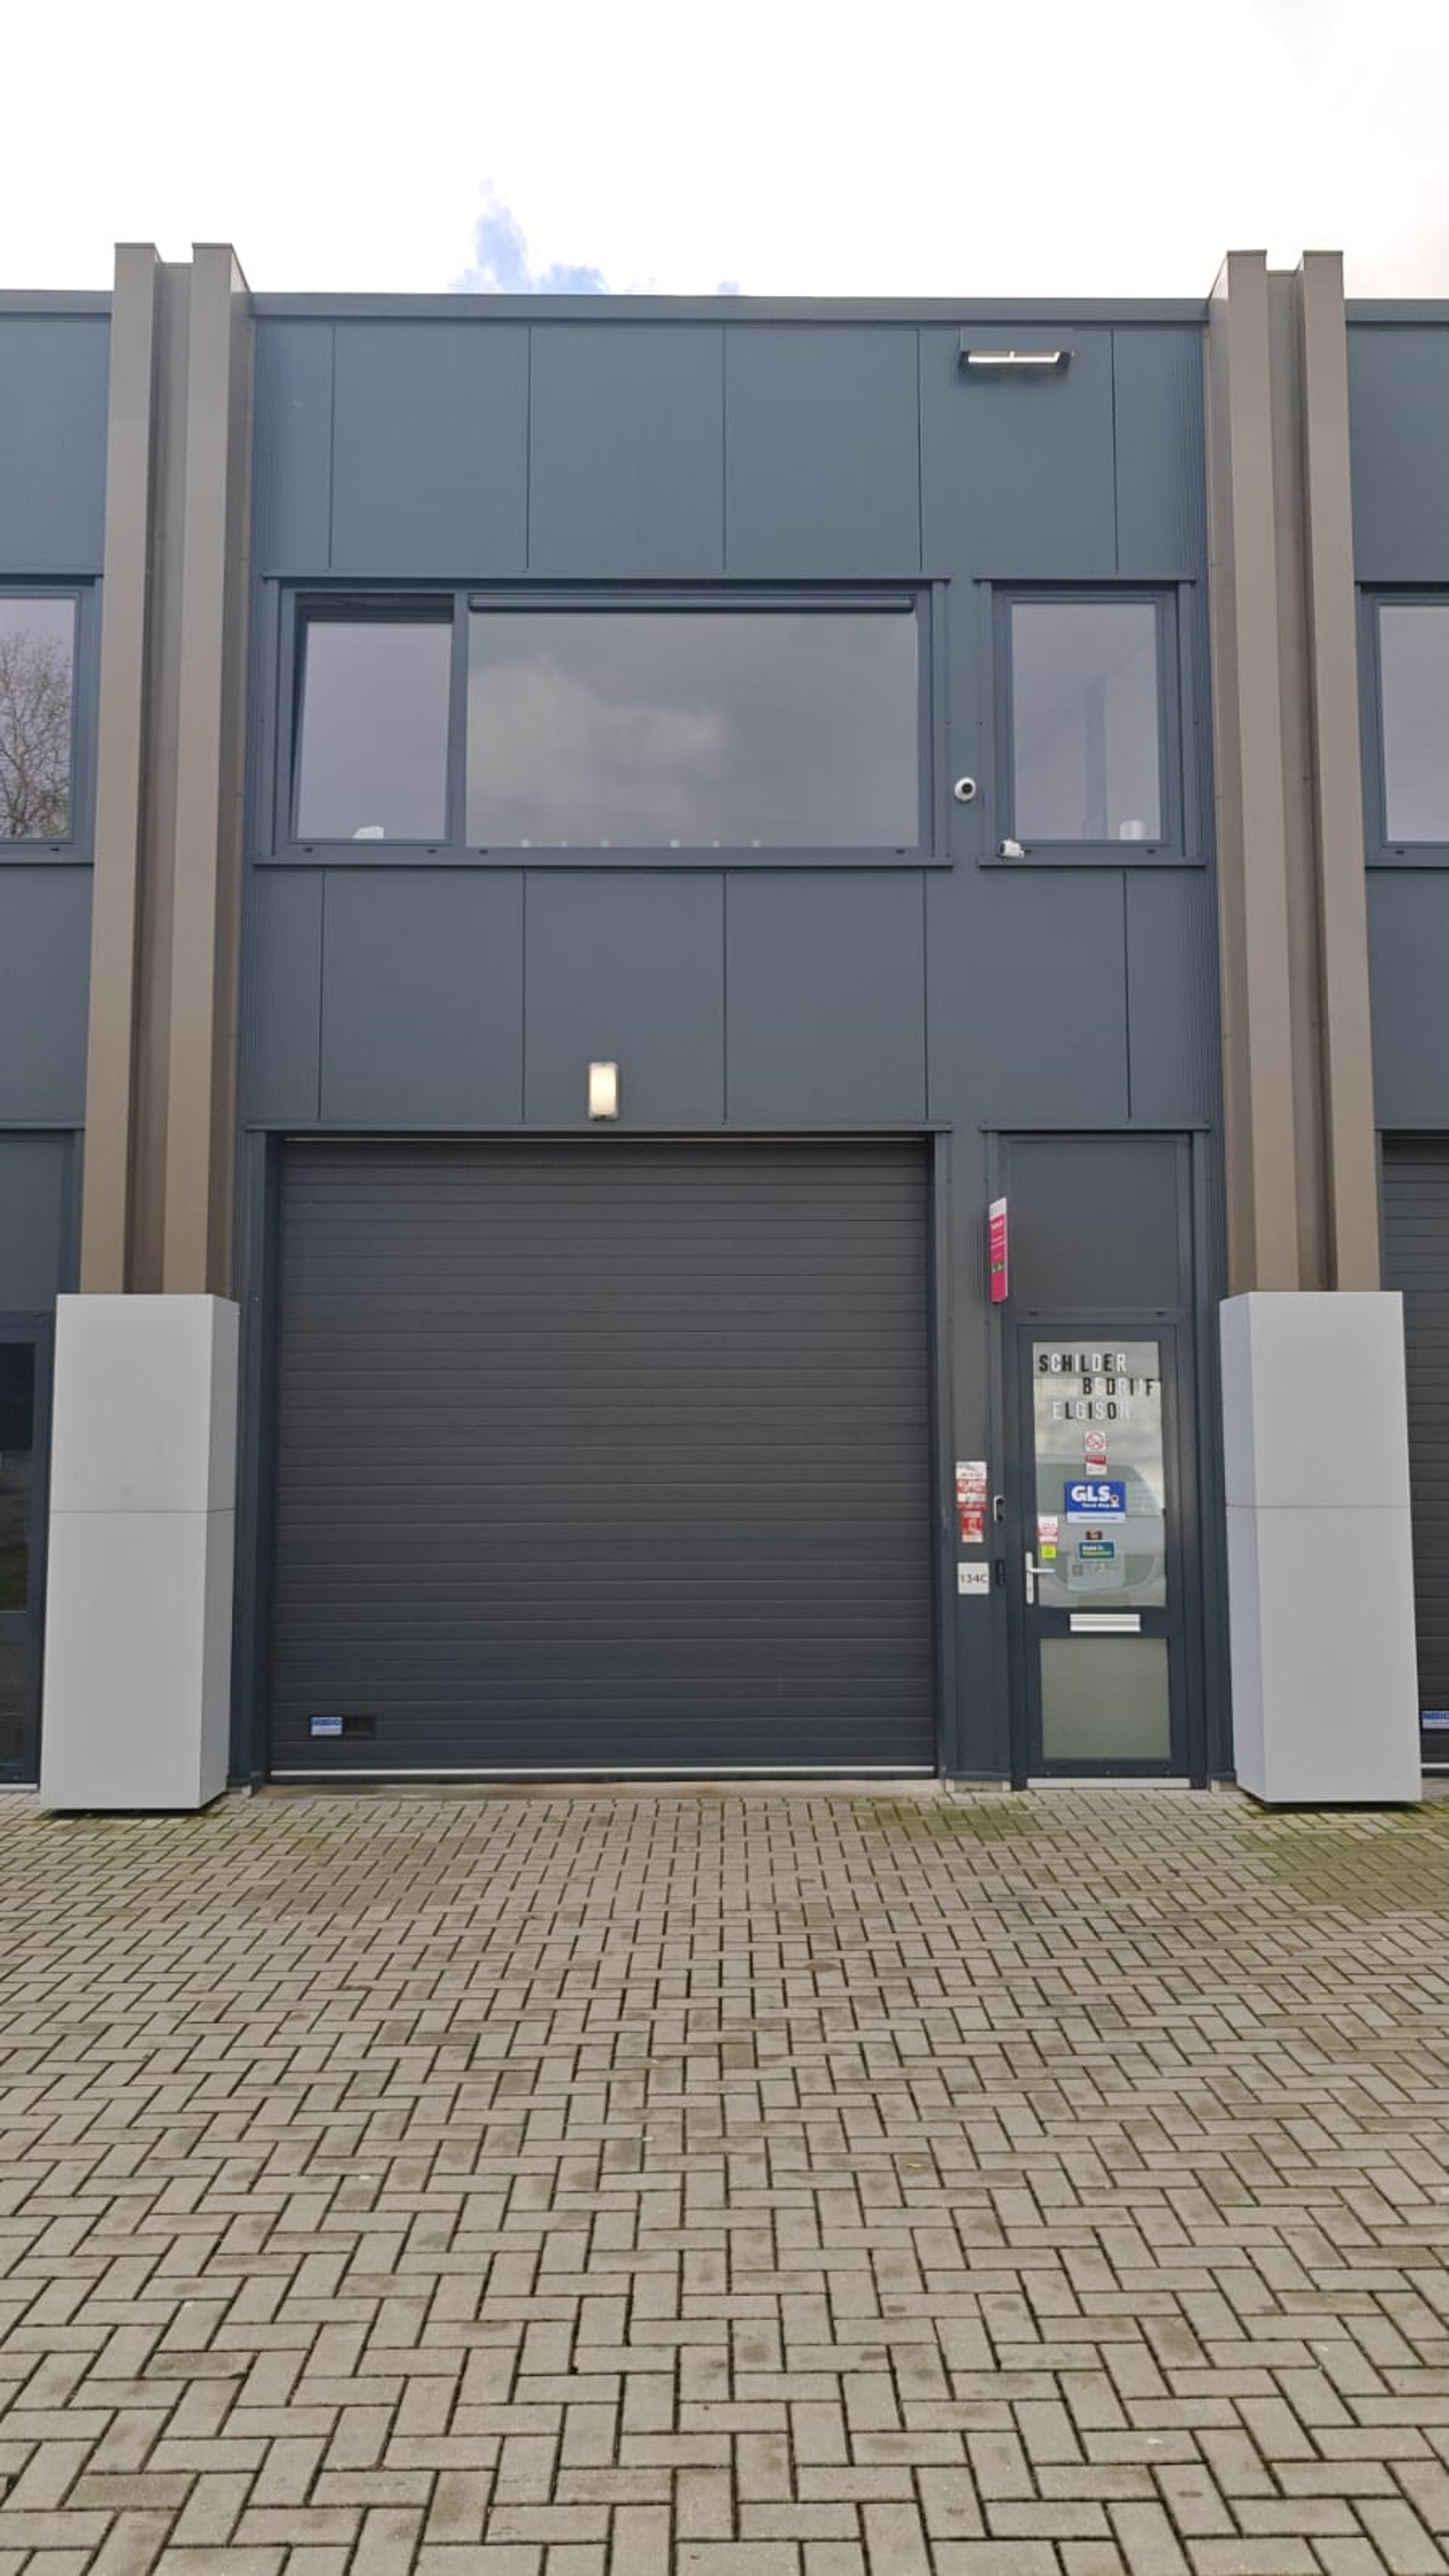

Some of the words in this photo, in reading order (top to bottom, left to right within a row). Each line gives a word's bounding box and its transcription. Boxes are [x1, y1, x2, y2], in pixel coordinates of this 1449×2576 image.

[1038, 1353, 1127, 1373] SCHILDER
[1082, 1376, 1154, 1396] BEDRIJF
[1052, 1401, 1130, 1419] ELGISON
[1071, 1485, 1110, 1502] GLS
[961, 1572, 988, 1584] 134C
